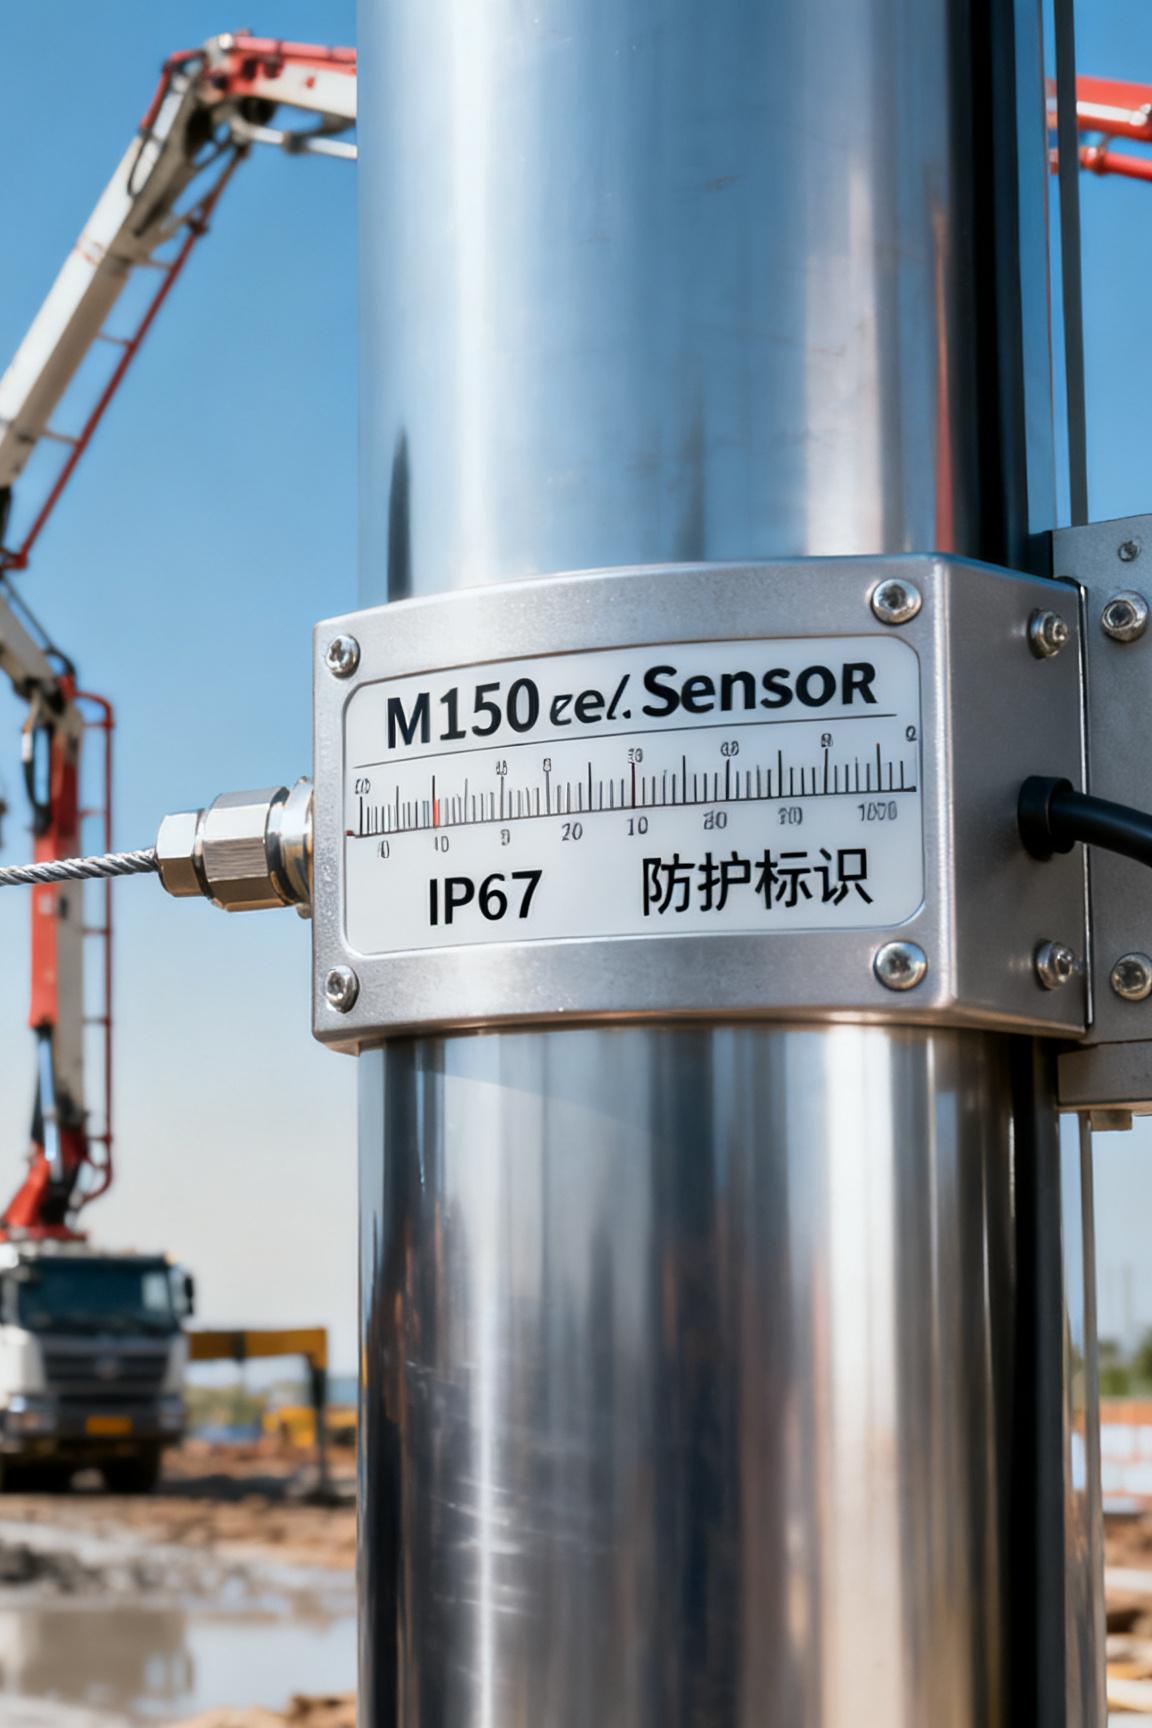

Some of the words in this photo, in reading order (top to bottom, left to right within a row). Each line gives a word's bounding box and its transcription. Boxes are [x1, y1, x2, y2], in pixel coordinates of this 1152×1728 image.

[387, 677, 539, 749] M150
[627, 816, 648, 836] 10
[429, 869, 543, 926] IP67
[642, 847, 874, 917] 防护标识
